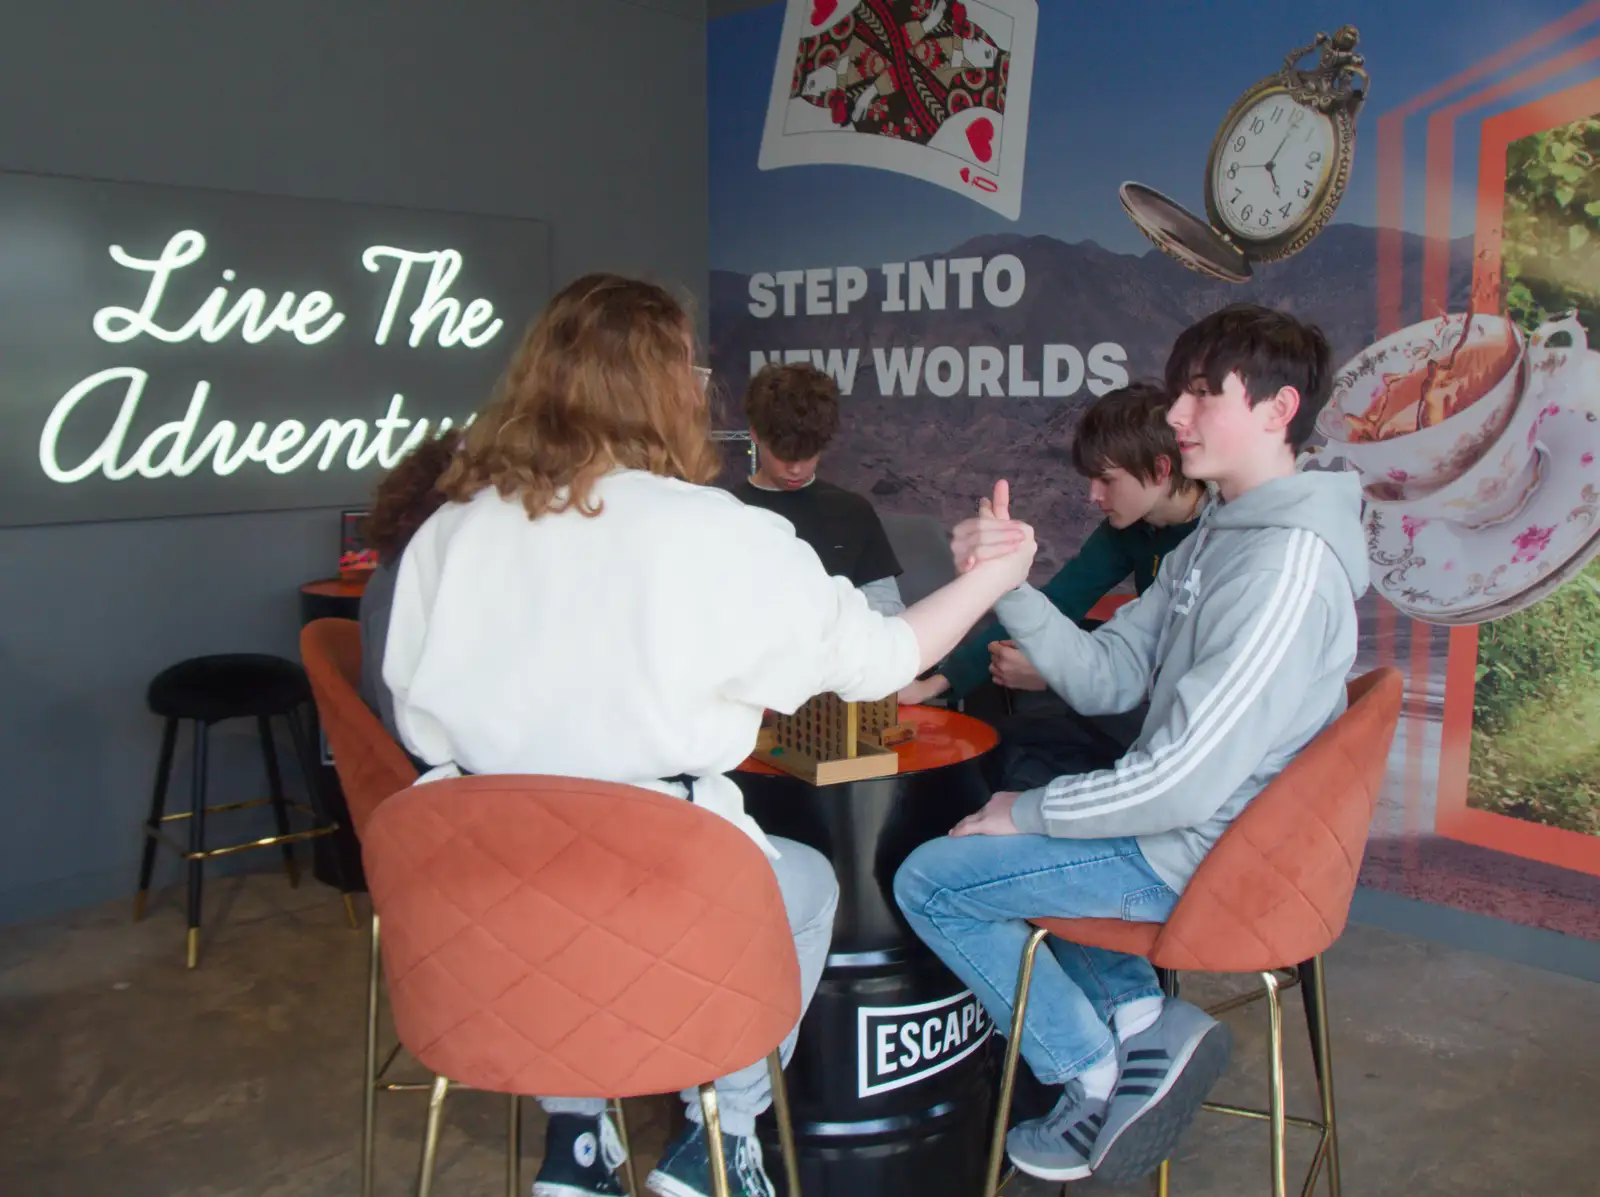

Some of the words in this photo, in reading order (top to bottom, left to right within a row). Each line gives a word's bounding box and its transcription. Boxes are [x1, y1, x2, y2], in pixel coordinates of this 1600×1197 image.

[1249, 116, 1265, 135] 10
[1233, 135, 1246, 152] 9
[1227, 162, 1240, 180] 8
[1230, 187, 1243, 204] 7
[1240, 204, 1253, 222] 6
[1259, 208, 1272, 227] 5
[1278, 202, 1292, 219] 4
[93, 229, 346, 345] Live
[362, 245, 504, 349] The
[748, 266, 869, 318] STEP
[881, 253, 1027, 314] INTO
[873, 342, 1130, 398] WORLDS
[876, 998, 985, 1076] ESCAPE
